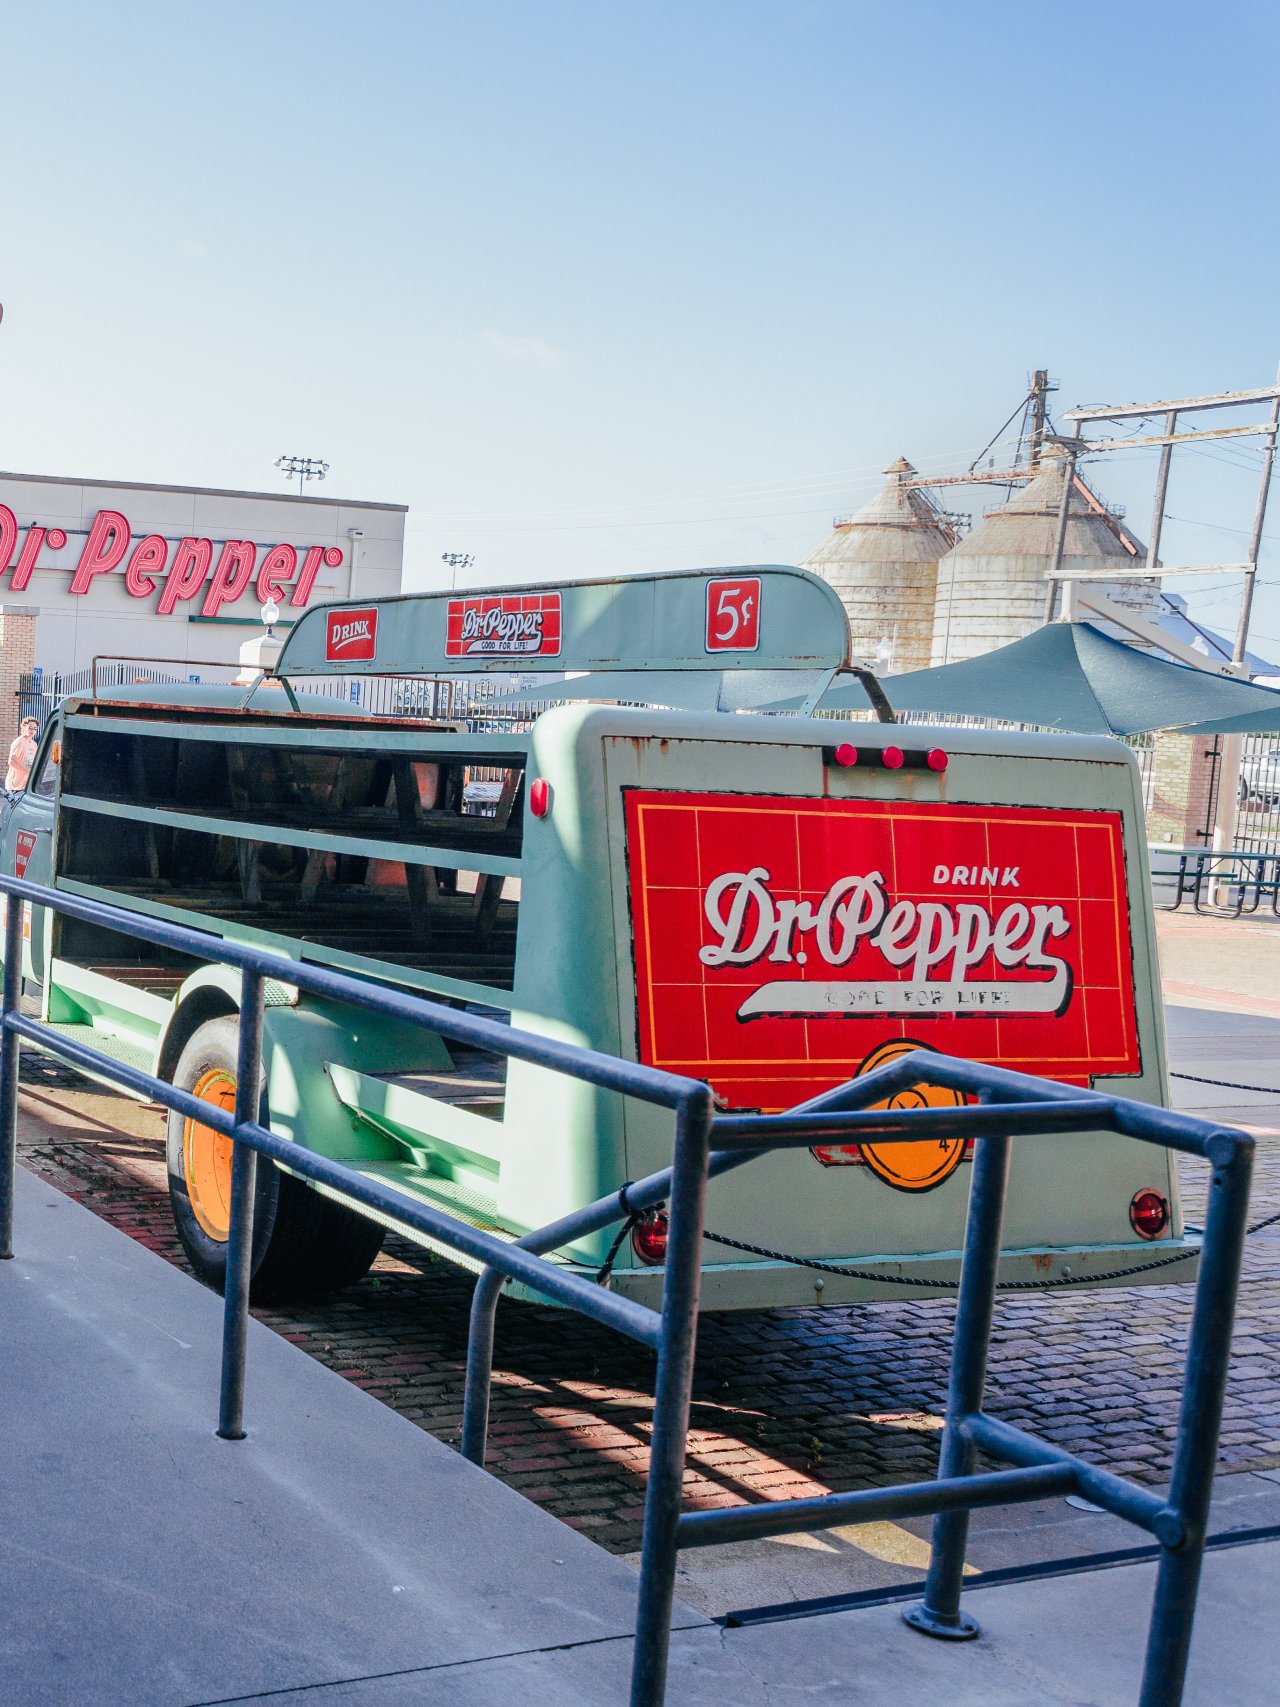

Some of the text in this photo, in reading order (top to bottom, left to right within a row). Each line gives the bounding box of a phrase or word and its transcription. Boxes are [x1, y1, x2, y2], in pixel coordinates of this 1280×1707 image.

[68, 510, 344, 617] Pepper
[481, 606, 543, 640] Pepper
[715, 588, 754, 641] 5¢
[331, 620, 370, 644] DRINK
[481, 641, 528, 650] GOOD FOR LIFE!
[933, 865, 1020, 887] DRINK
[817, 871, 1071, 985] Pepper
